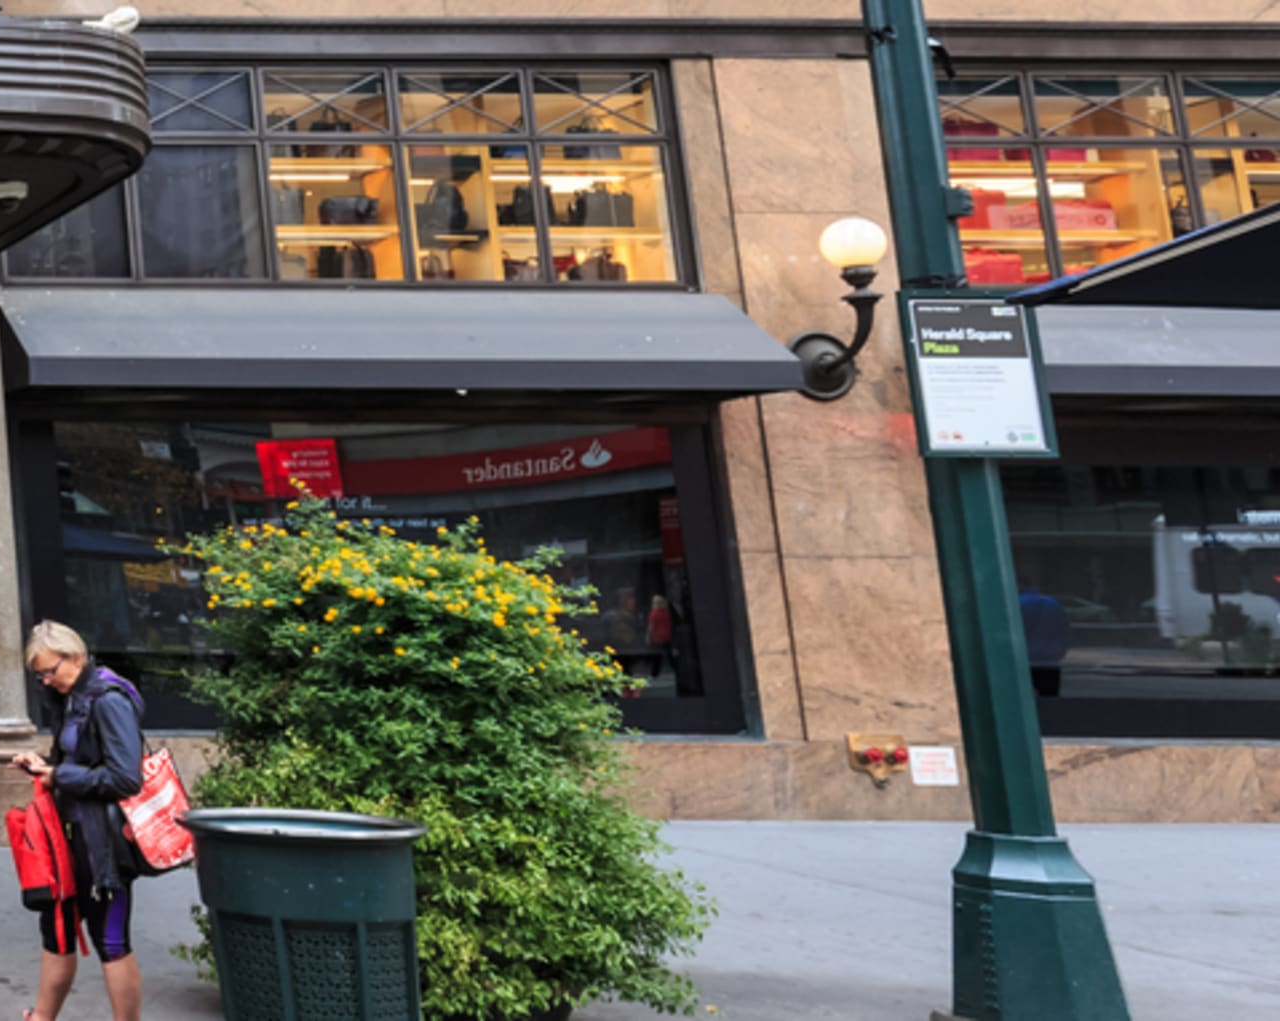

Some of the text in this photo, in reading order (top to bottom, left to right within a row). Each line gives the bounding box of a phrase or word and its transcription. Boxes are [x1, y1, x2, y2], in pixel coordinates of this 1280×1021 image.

[921, 328, 1014, 343] Herald Square
[923, 341, 960, 354] Plaza
